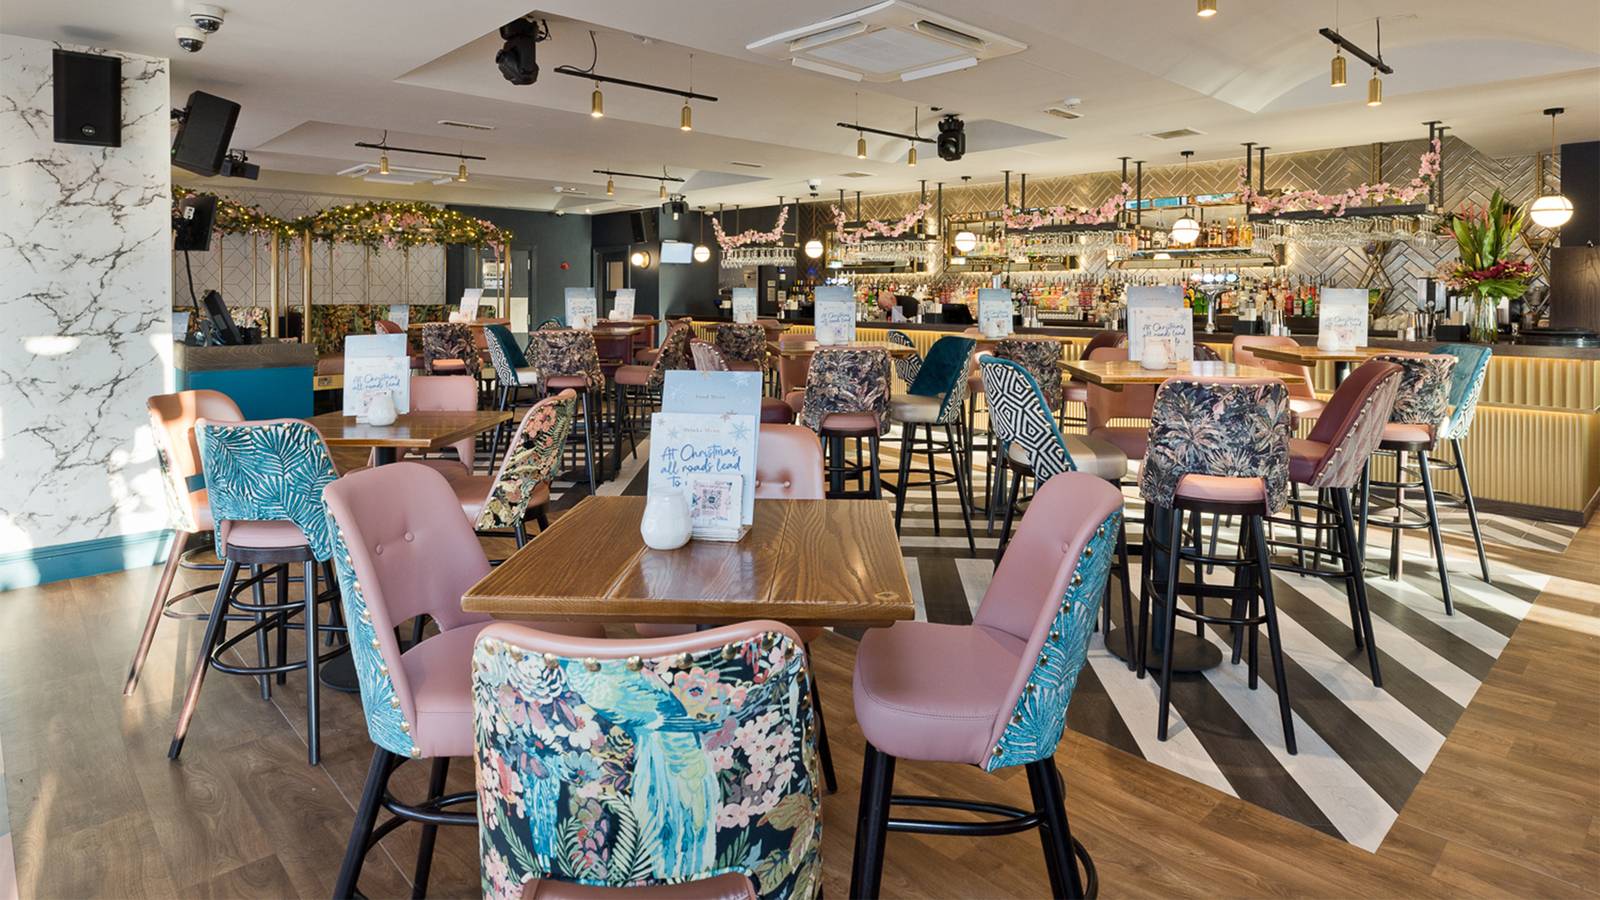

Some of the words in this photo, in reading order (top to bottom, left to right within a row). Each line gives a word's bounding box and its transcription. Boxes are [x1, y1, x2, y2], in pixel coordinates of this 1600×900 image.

[661, 446, 678, 461] At
[680, 444, 738, 461] Christmas
[660, 461, 679, 474] all
[682, 458, 713, 473] roads
[717, 456, 741, 472] lead
[667, 475, 681, 488] to
